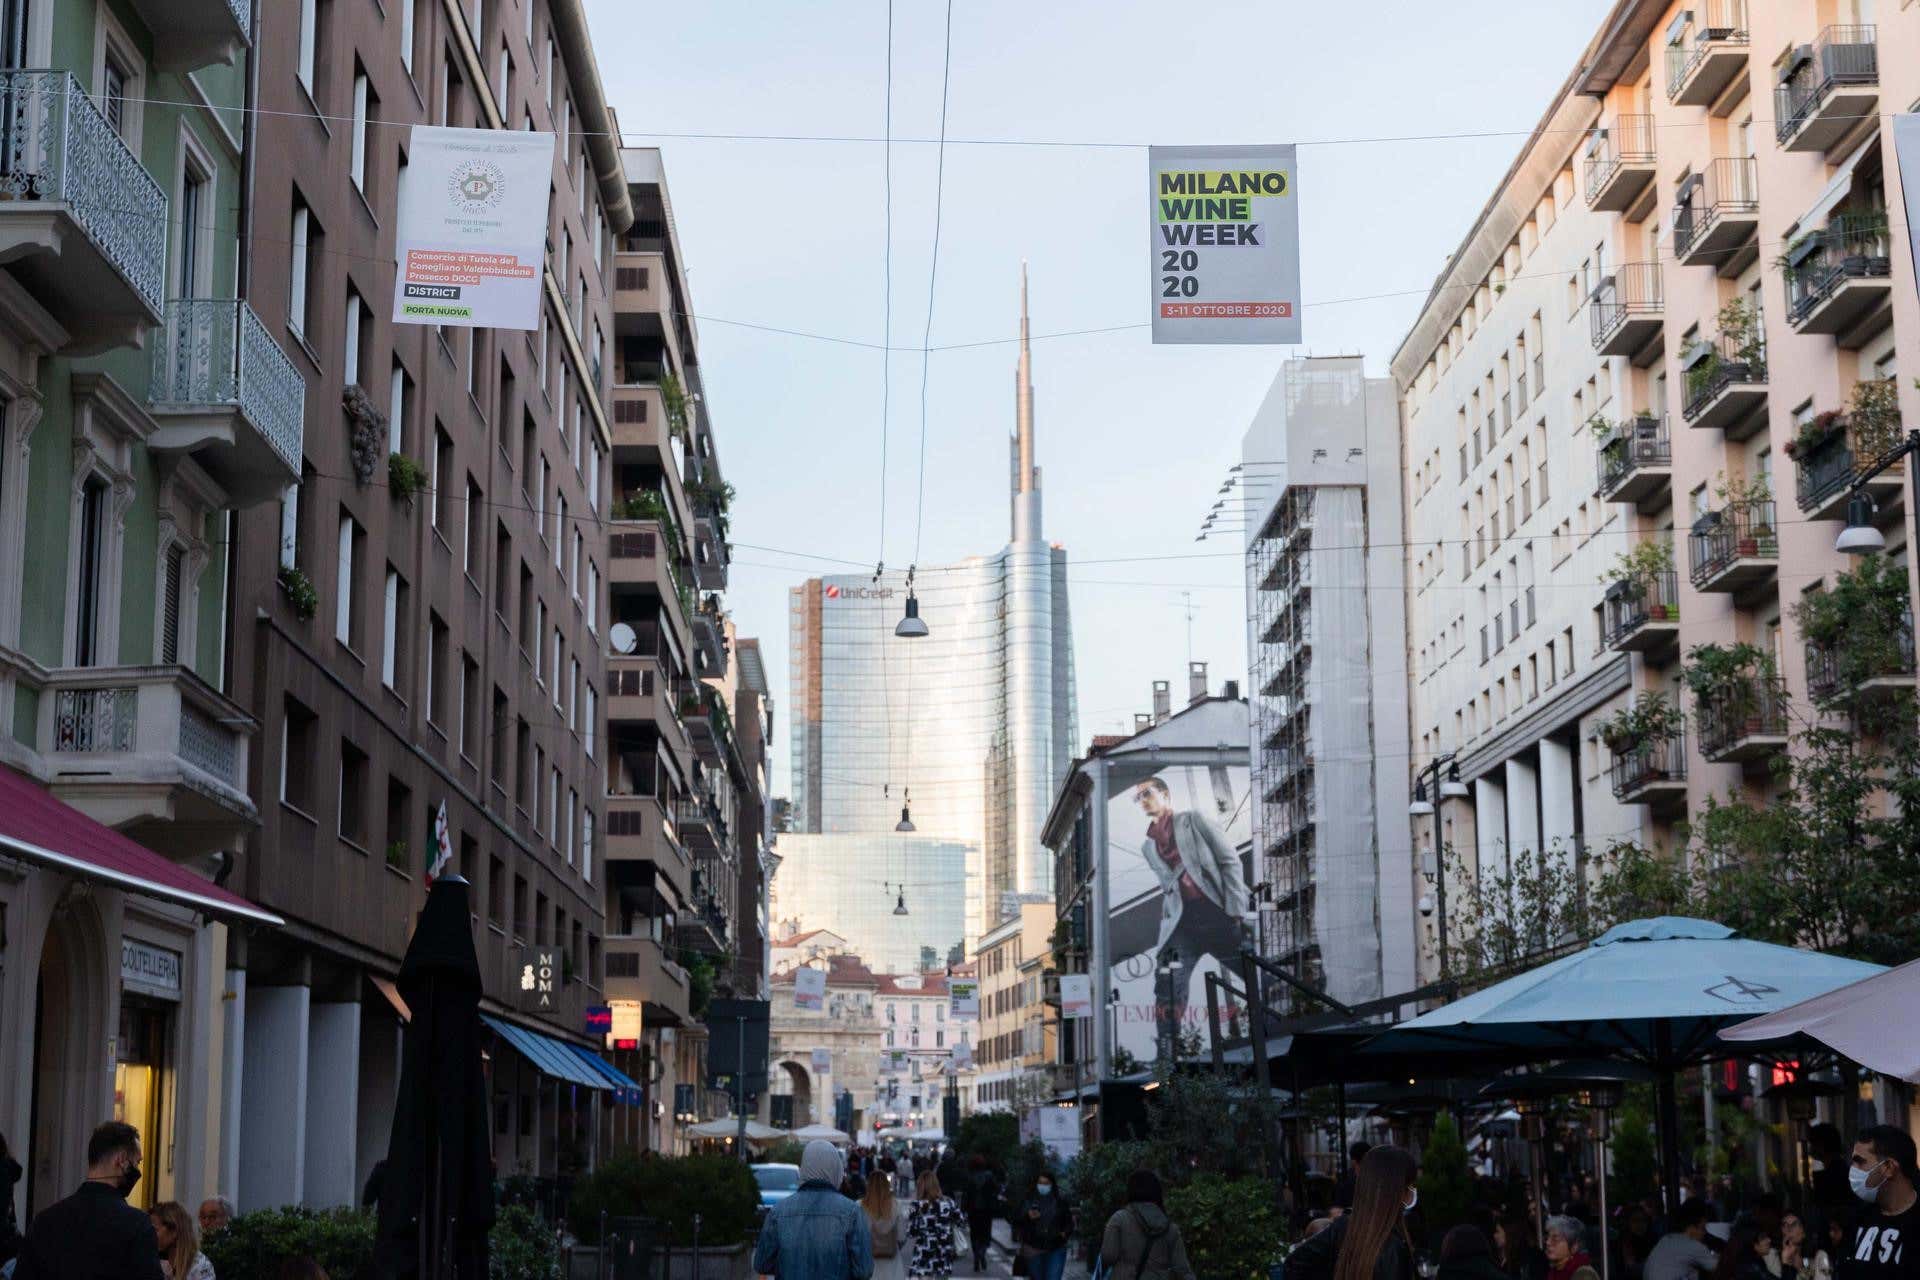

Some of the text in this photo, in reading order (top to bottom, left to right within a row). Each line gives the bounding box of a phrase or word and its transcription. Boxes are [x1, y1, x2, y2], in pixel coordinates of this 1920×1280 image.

[1160, 173, 1286, 195] MILANO
[1160, 198, 1248, 220] WINE
[1160, 224, 1260, 245] WEEK
[411, 252, 514, 265] Consorzio di Tutela del
[1162, 250, 1199, 271] 20
[409, 272, 479, 283] Prosecco DOCG
[410, 262, 531, 276] Conegliano Valdobbiadene
[408, 286, 457, 298] DISTRICT
[1162, 276, 1199, 297] 20
[406, 306, 469, 316] PORTA NUOVA
[1167, 305, 1286, 316] 3-11 OTTOBRE 2020
[841, 587, 894, 599] UniCredit
[121, 946, 177, 978] COLTELLERIA
[539, 953, 553, 1006] MOMA
